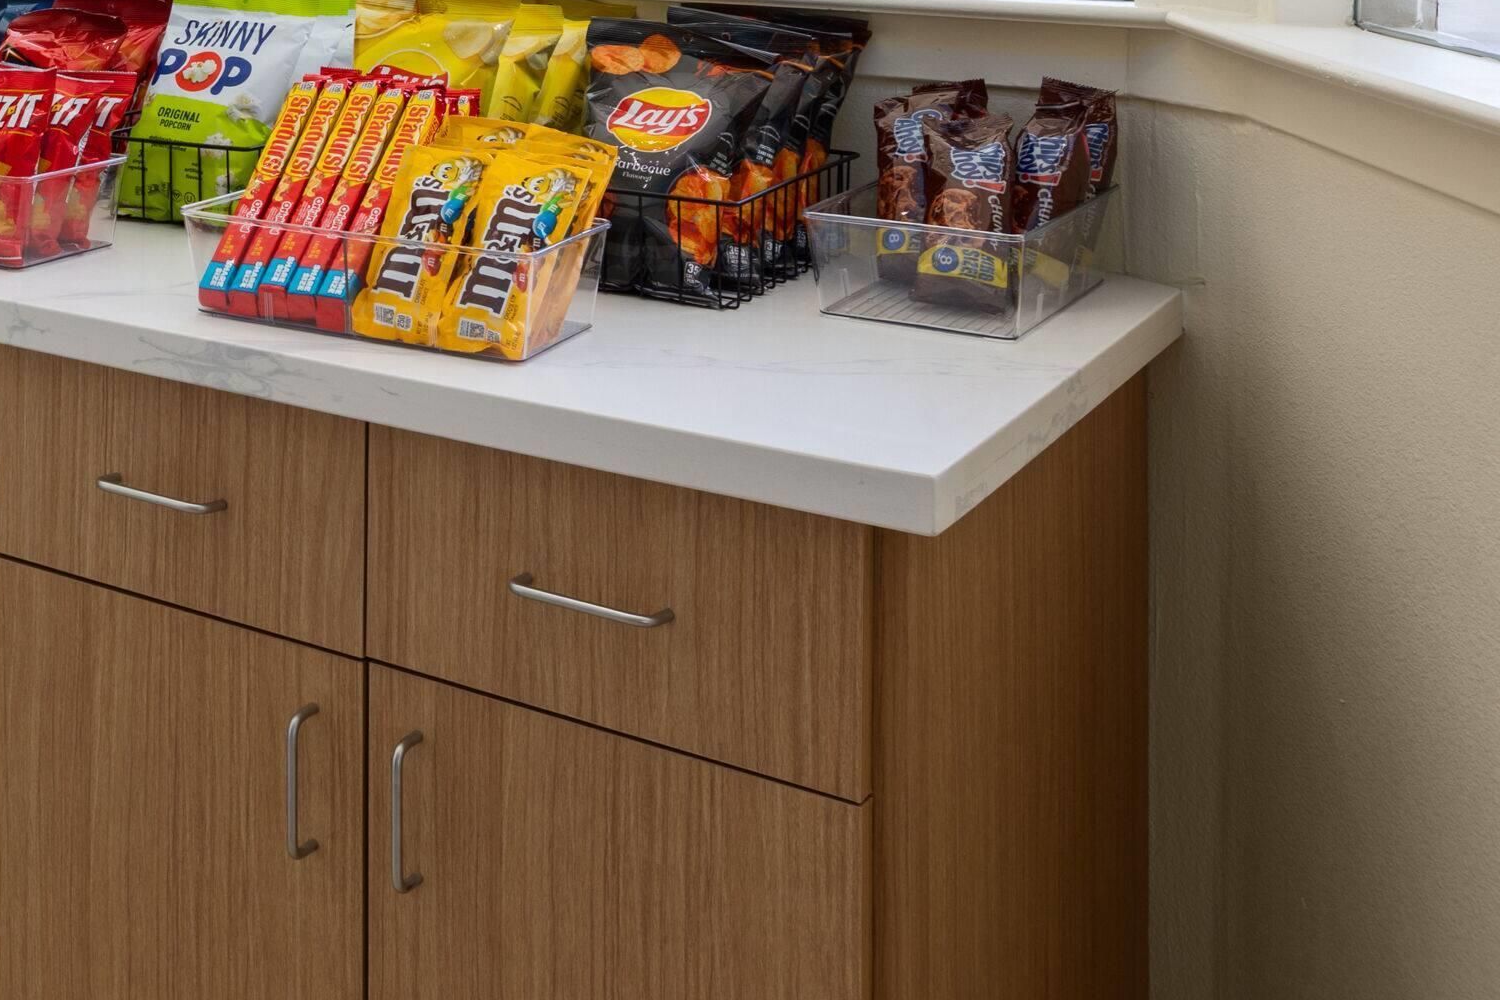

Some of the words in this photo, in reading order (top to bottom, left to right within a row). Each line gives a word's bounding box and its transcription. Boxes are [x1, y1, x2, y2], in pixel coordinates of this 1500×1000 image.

[151, 48, 252, 95] POP
[158, 106, 200, 123] ORIGINAL
[159, 118, 192, 131] POPCORN
[260, 95, 311, 175] Starburst
[322, 95, 372, 172] Starburst
[613, 100, 706, 135] Lay's
[290, 98, 339, 177] Starburst
[348, 103, 397, 181] Starburst
[1039, 134, 1067, 174] hips
[301, 197, 325, 232] Origina
[329, 205, 350, 238] Origin
[988, 195, 1003, 250] CHUNY
